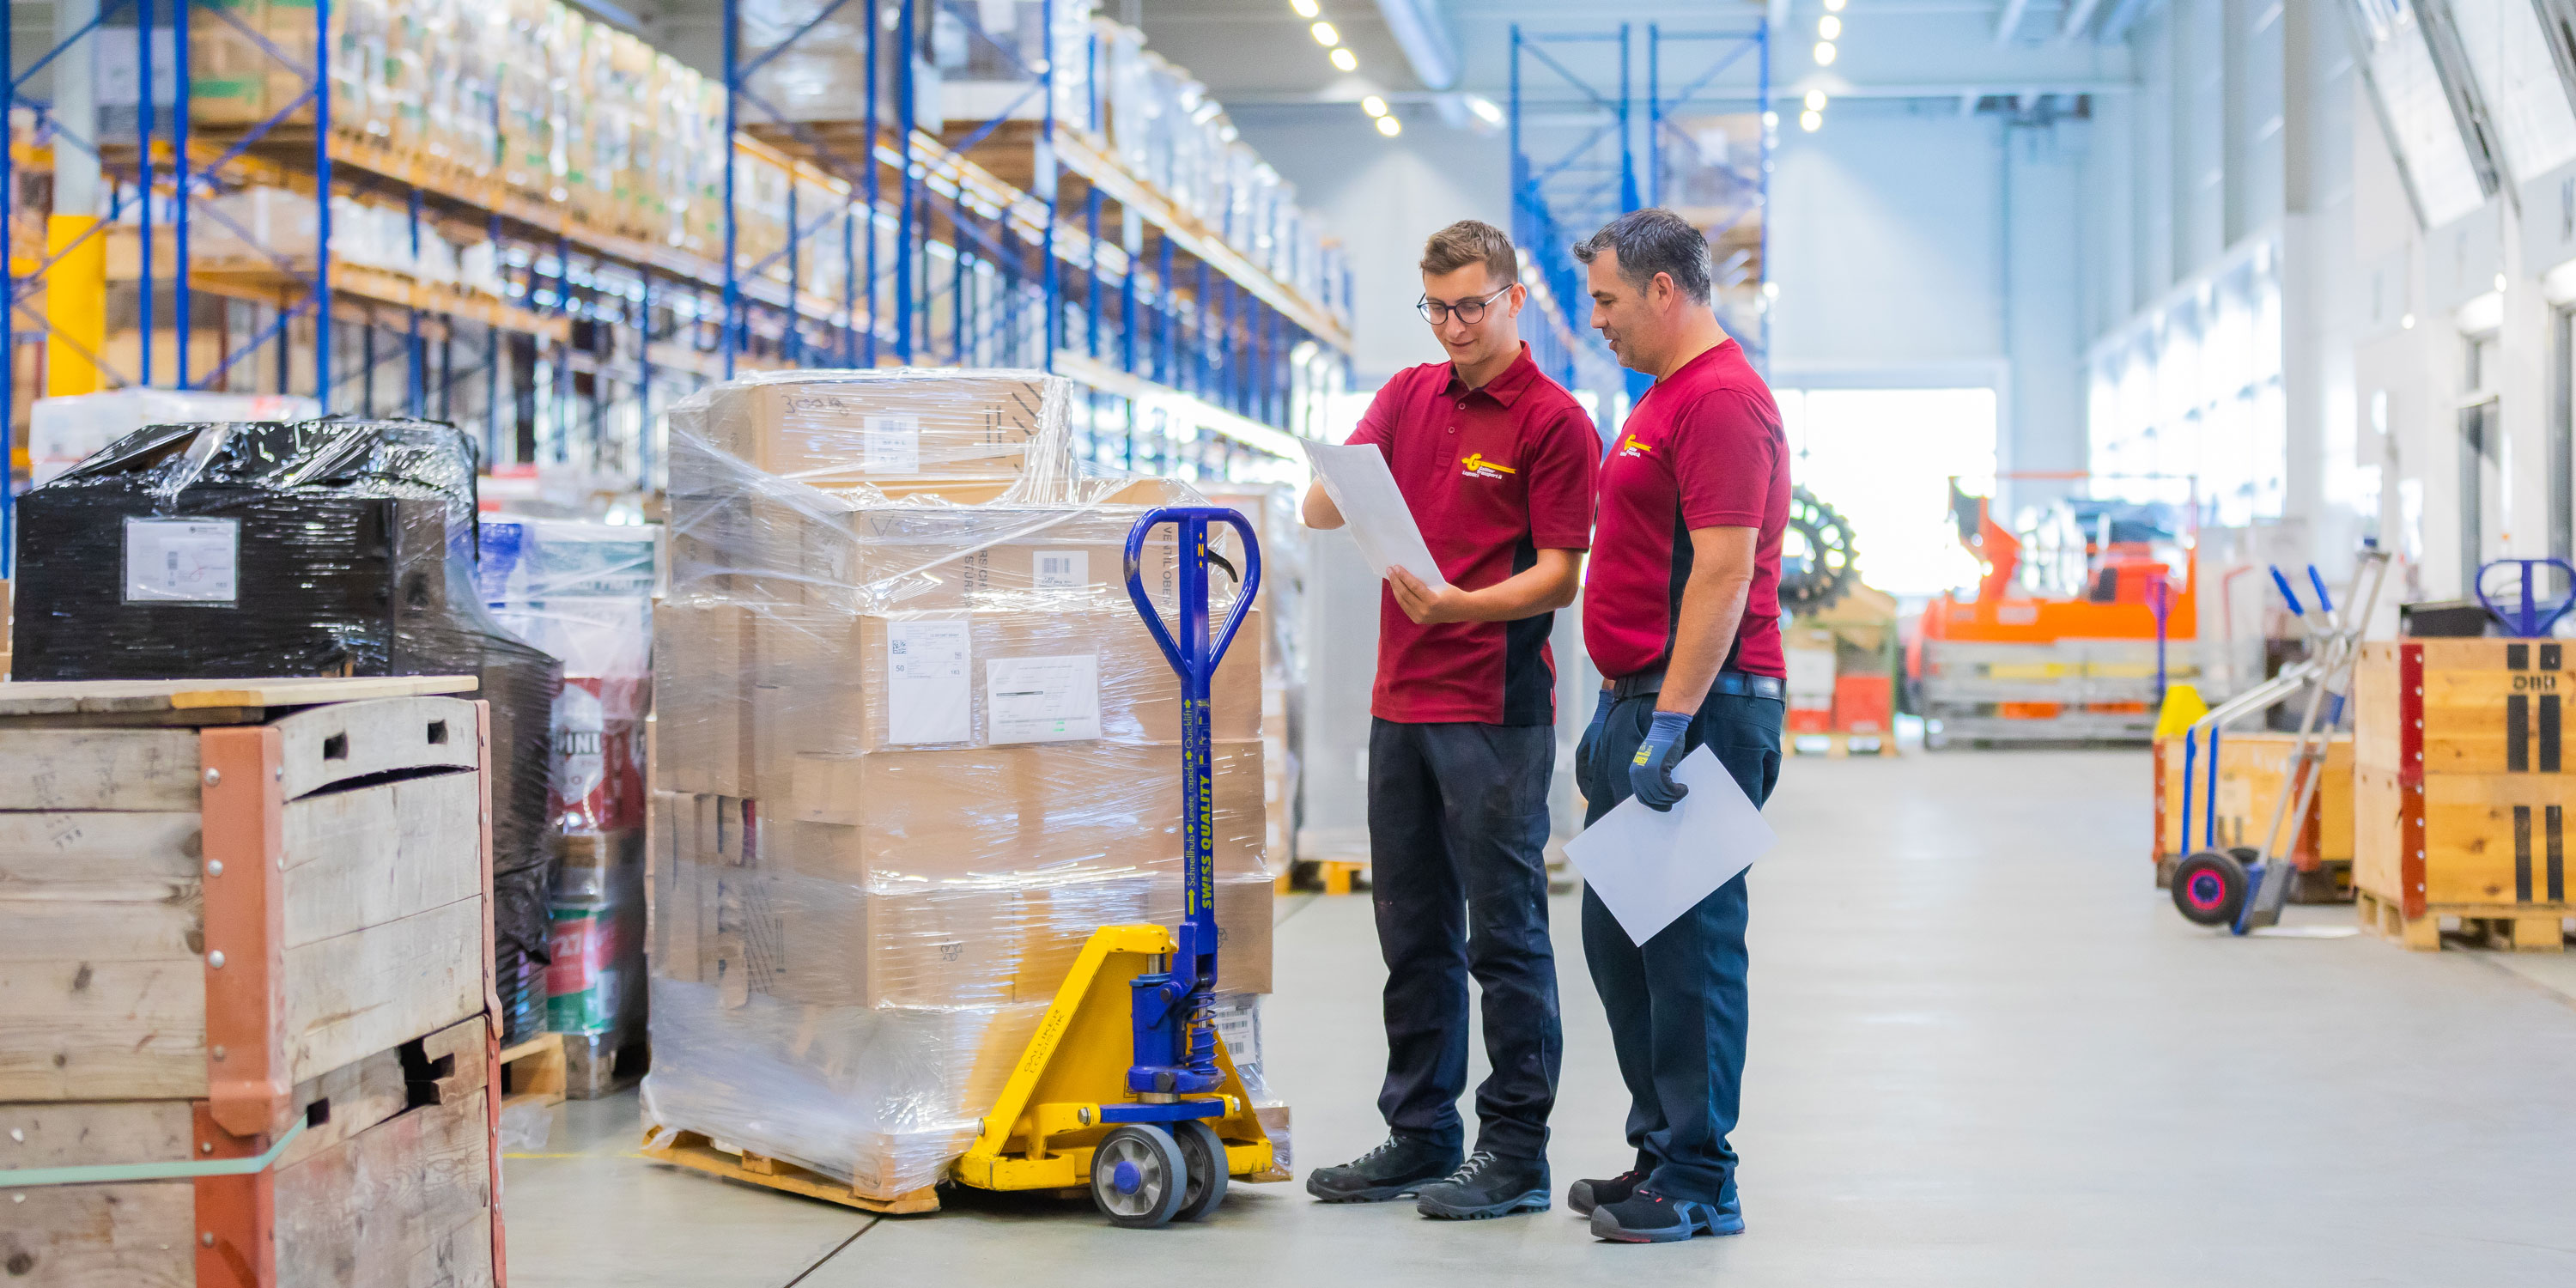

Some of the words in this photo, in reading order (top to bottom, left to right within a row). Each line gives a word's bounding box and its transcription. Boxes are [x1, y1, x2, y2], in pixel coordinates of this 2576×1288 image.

[1198, 544, 1204, 556] N
[1184, 709, 1194, 749] Quicklift
[1185, 761, 1194, 793] rapide
[1200, 775, 1212, 850] QUALITY
[1187, 835, 1195, 887] Schnellhub
[1201, 856, 1212, 909] SWISS
[1030, 1014, 1065, 1073] LOGISTIK
